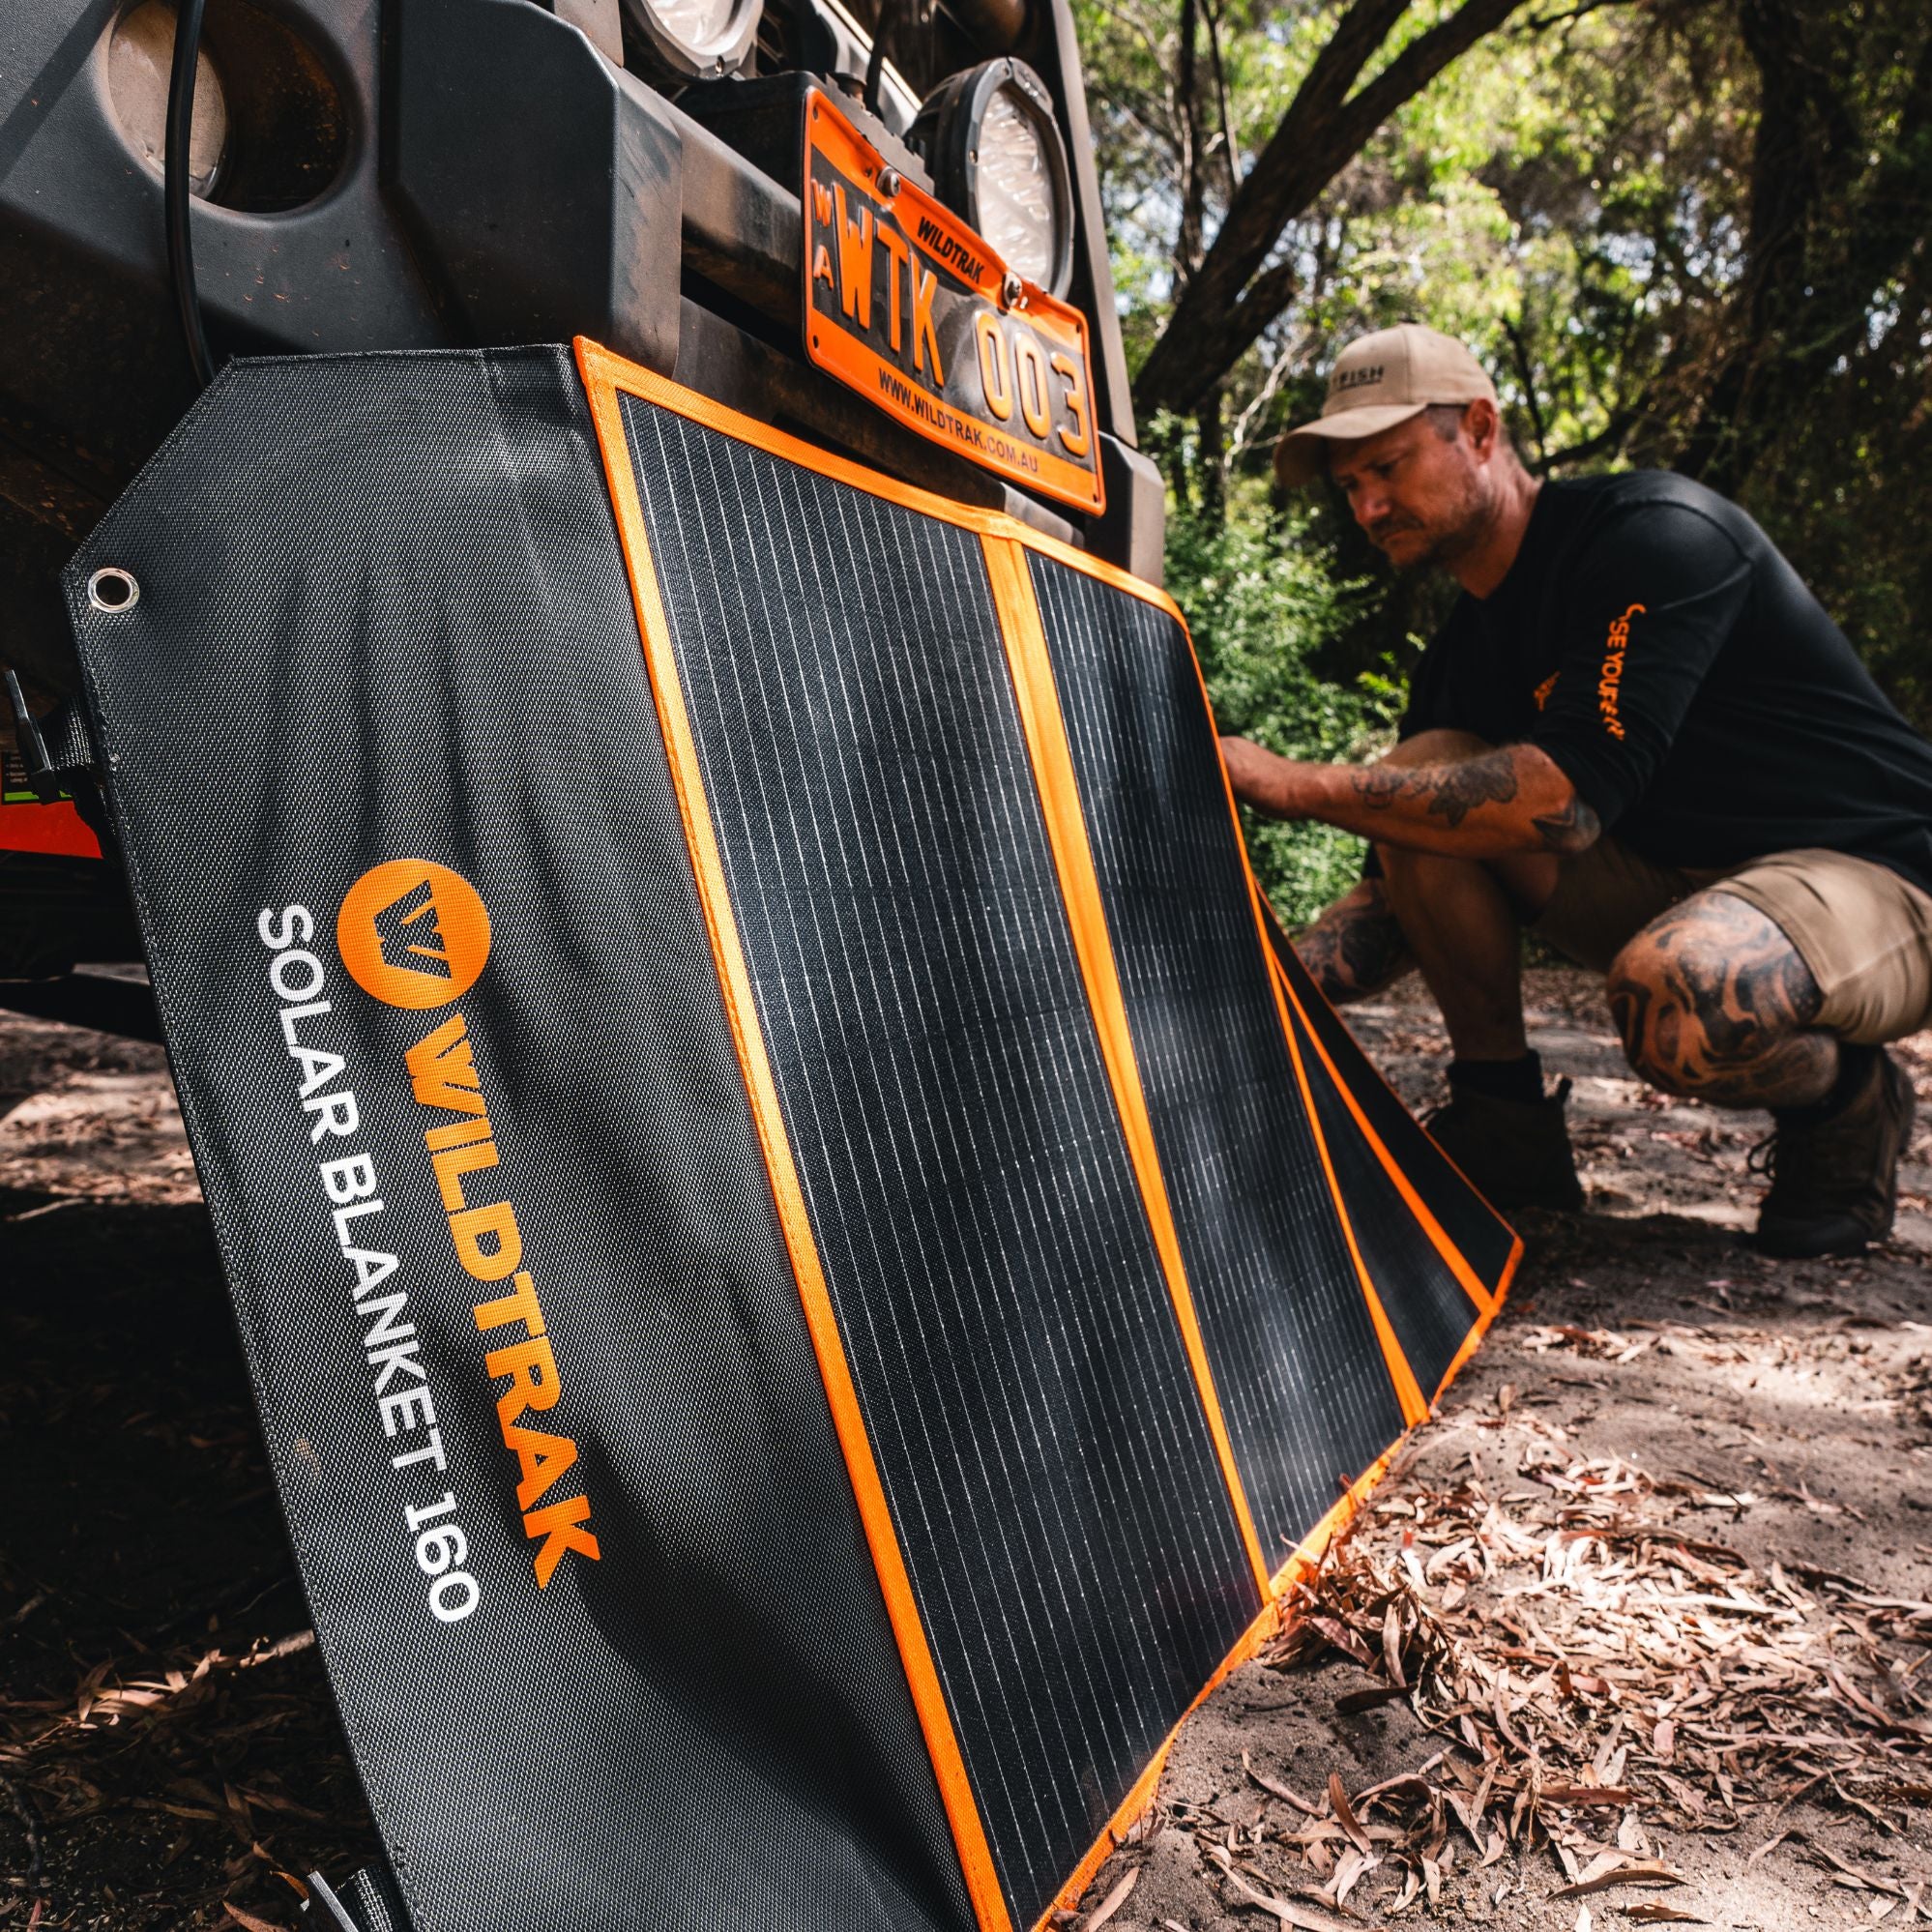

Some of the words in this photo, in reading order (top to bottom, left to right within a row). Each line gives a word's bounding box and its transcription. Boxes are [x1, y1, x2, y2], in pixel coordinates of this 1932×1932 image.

[834, 182, 944, 387] WTK
[976, 311, 1089, 456] 003
[918, 216, 984, 284] WILDTRAK
[878, 367, 1039, 473] WWW.WILDTRAK.COM.AU
[257, 904, 360, 1146] SOLAR
[322, 1153, 448, 1472] BLANKET
[404, 1491, 480, 1623] 160
[405, 1012, 600, 1590] WILDTRAK
